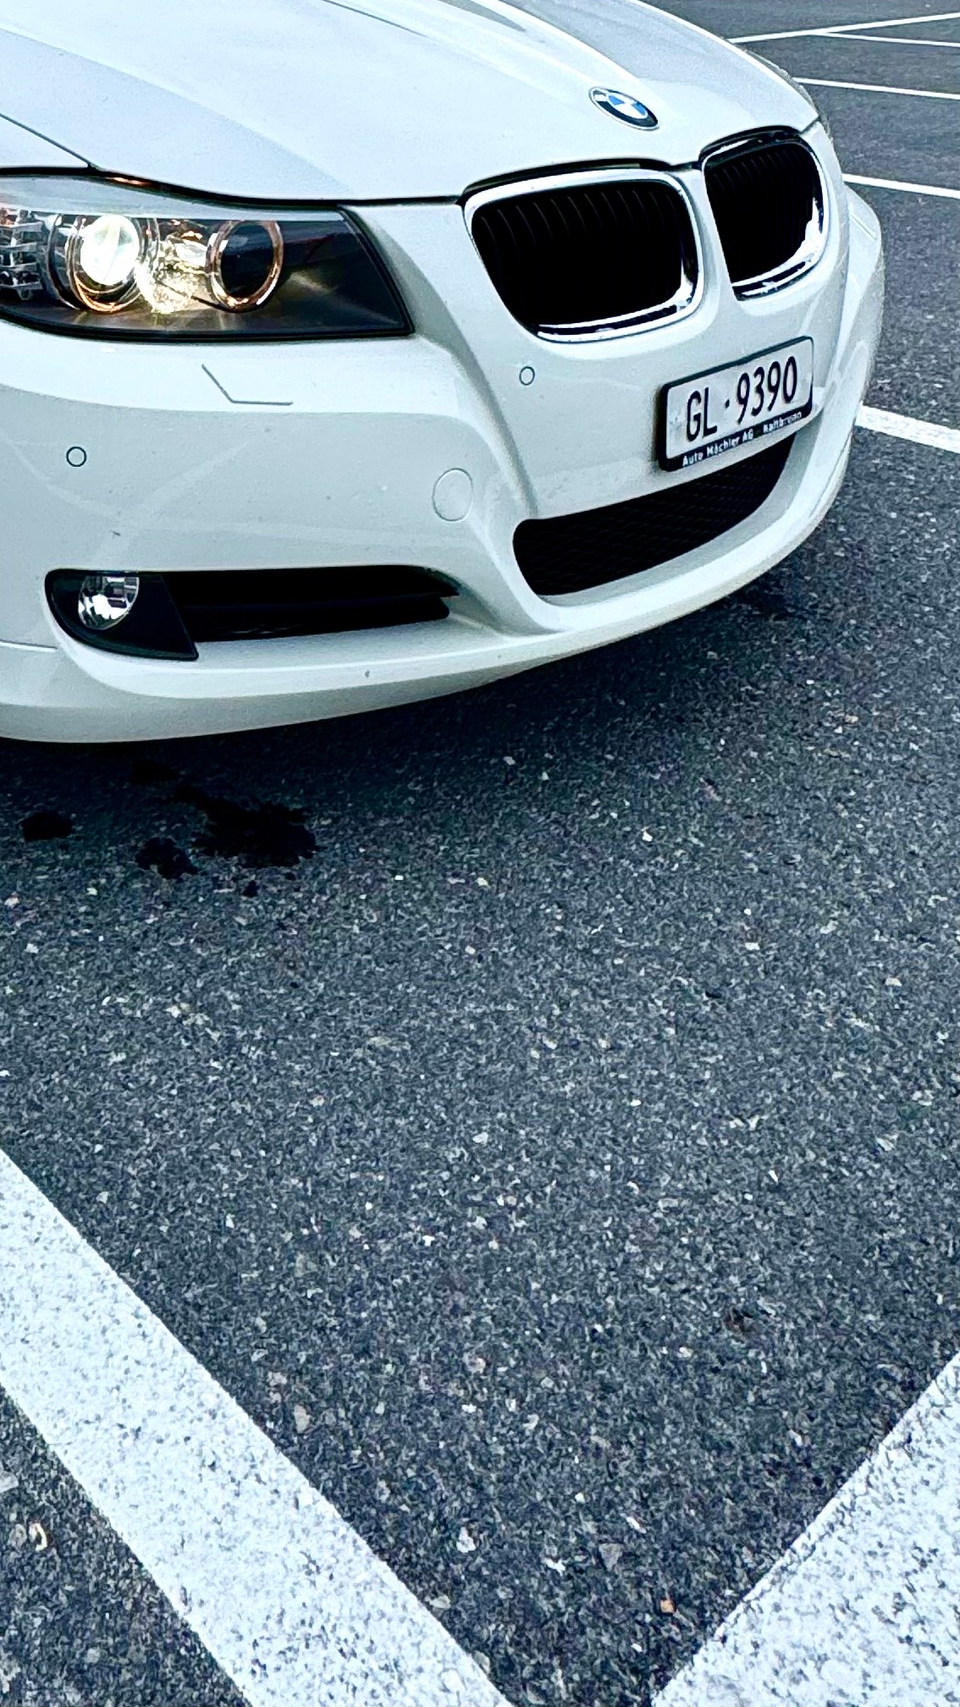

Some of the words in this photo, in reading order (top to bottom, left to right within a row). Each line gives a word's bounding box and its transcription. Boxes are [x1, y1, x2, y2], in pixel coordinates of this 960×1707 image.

[686, 386, 718, 442] GL
[736, 356, 798, 425] 9390
[682, 451, 704, 467] Auto
[742, 428, 754, 443] AG
